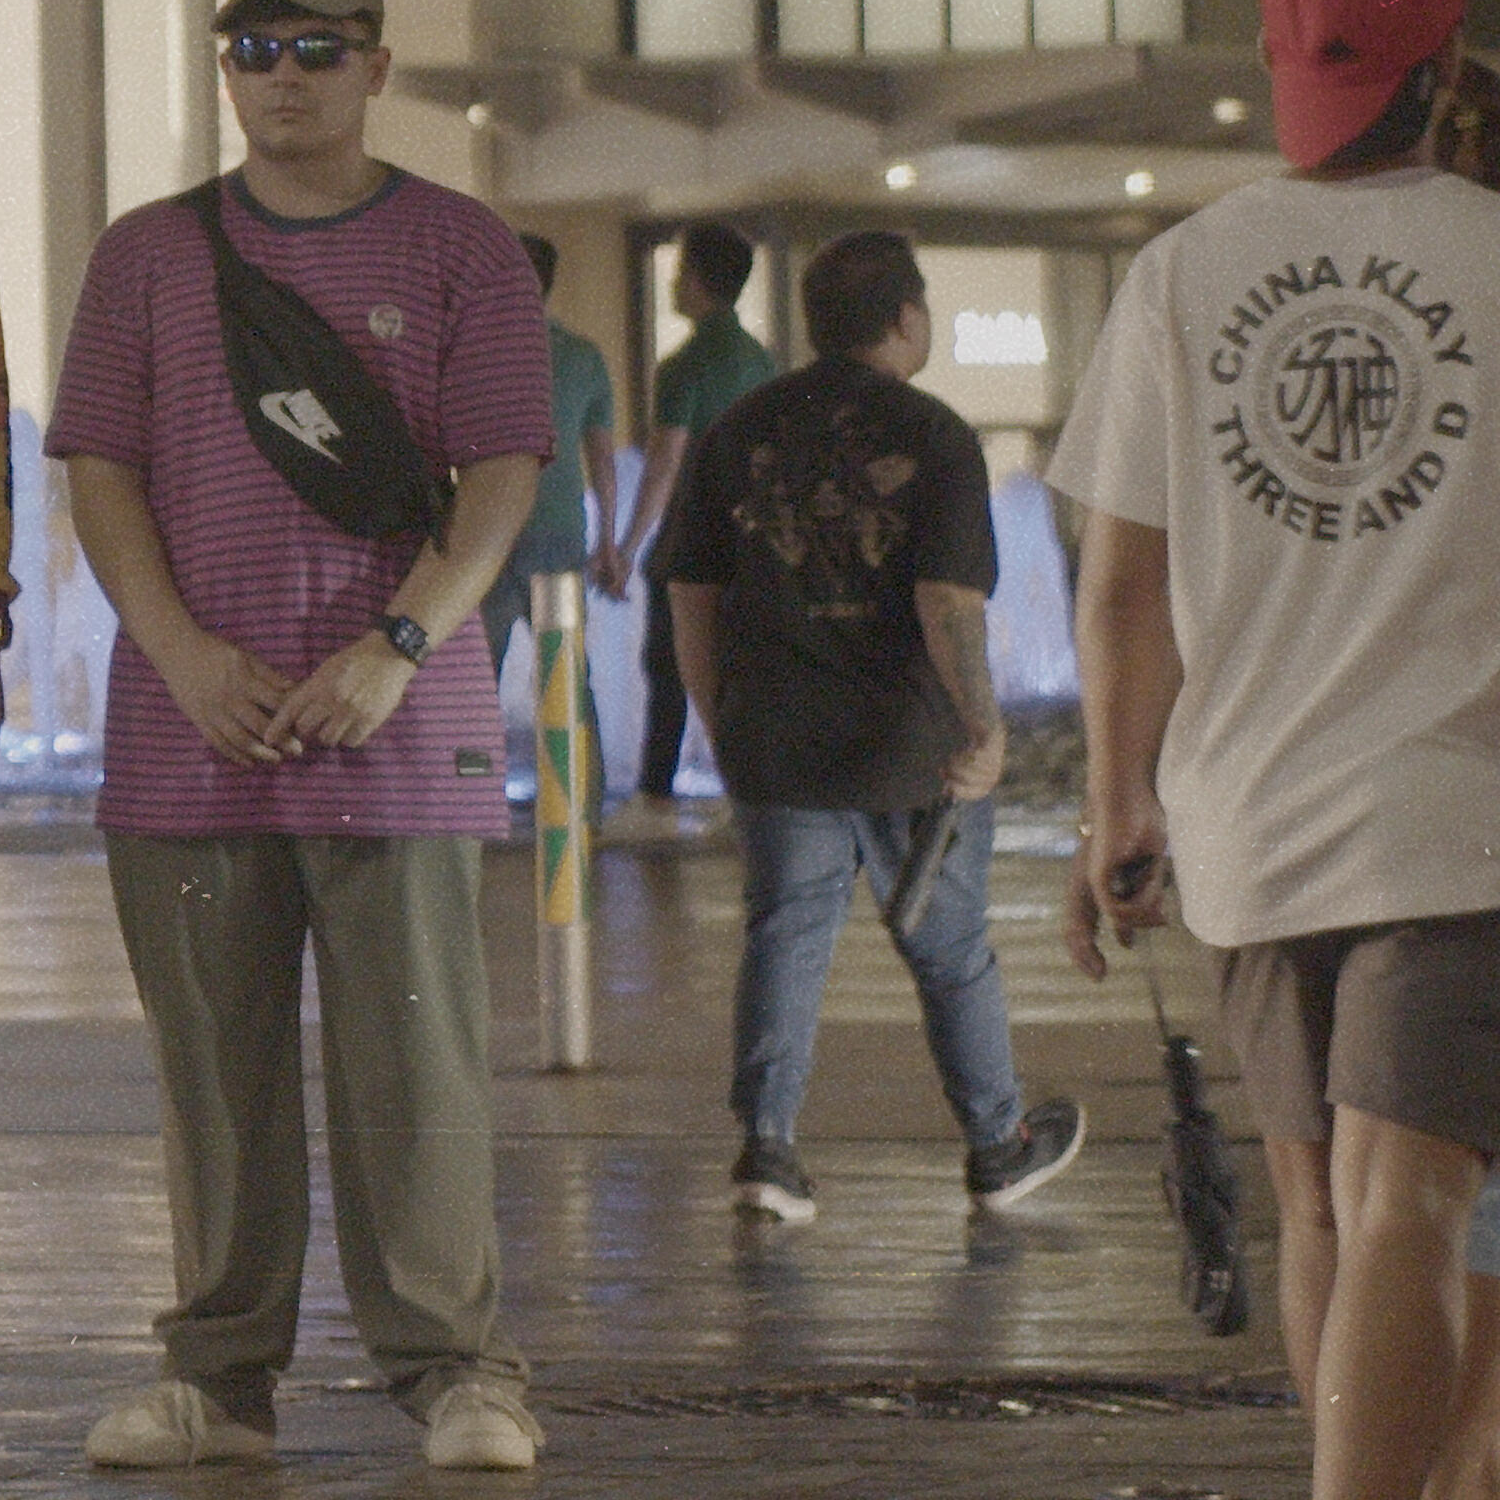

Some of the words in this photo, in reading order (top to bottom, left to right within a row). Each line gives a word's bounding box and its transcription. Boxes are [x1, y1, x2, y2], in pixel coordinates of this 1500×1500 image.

[1208, 255, 1343, 385] CHINA
[1358, 254, 1474, 366] KLAY
[1211, 402, 1342, 542] THREE
[1354, 450, 1446, 538] AND
[1432, 401, 1469, 440] D
